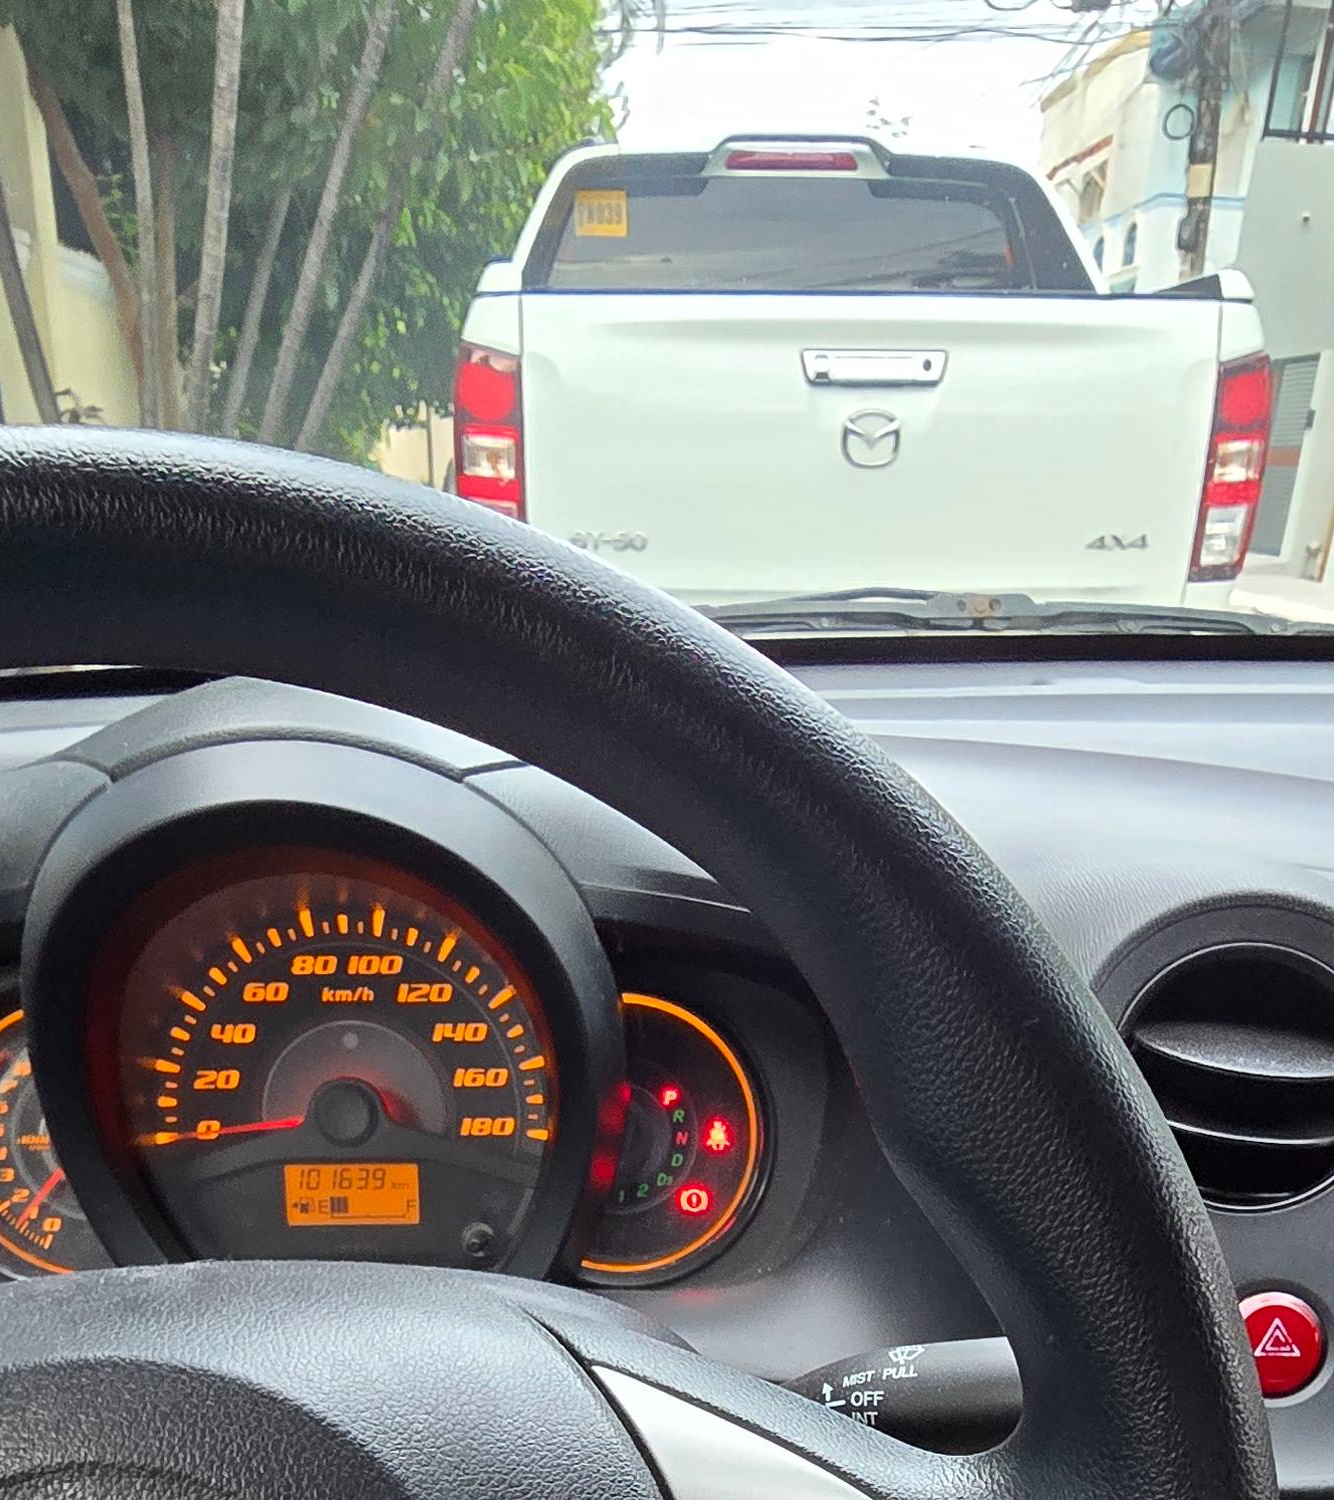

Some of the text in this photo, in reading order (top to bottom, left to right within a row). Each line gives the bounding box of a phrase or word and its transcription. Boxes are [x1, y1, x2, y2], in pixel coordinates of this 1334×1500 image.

[291, 955, 337, 975] 80
[347, 955, 404, 975] 100
[243, 982, 289, 1002] 60
[322, 987, 374, 1003] km/h
[396, 983, 453, 1003] 120
[210, 1023, 256, 1044] 40
[432, 1022, 487, 1042] 140
[193, 1070, 240, 1090] 20
[454, 1068, 508, 1087] 160
[663, 1091, 678, 1105] P
[672, 1110, 685, 1123] R
[196, 1120, 220, 1139] 0
[460, 1117, 515, 1136] 180
[675, 1132, 689, 1145] N
[671, 1154, 683, 1166] D
[637, 1183, 649, 1197] 2
[406, 1199, 417, 1213] F
[842, 1365, 918, 1388] MIST PULL
[850, 1391, 884, 1406] OFF
